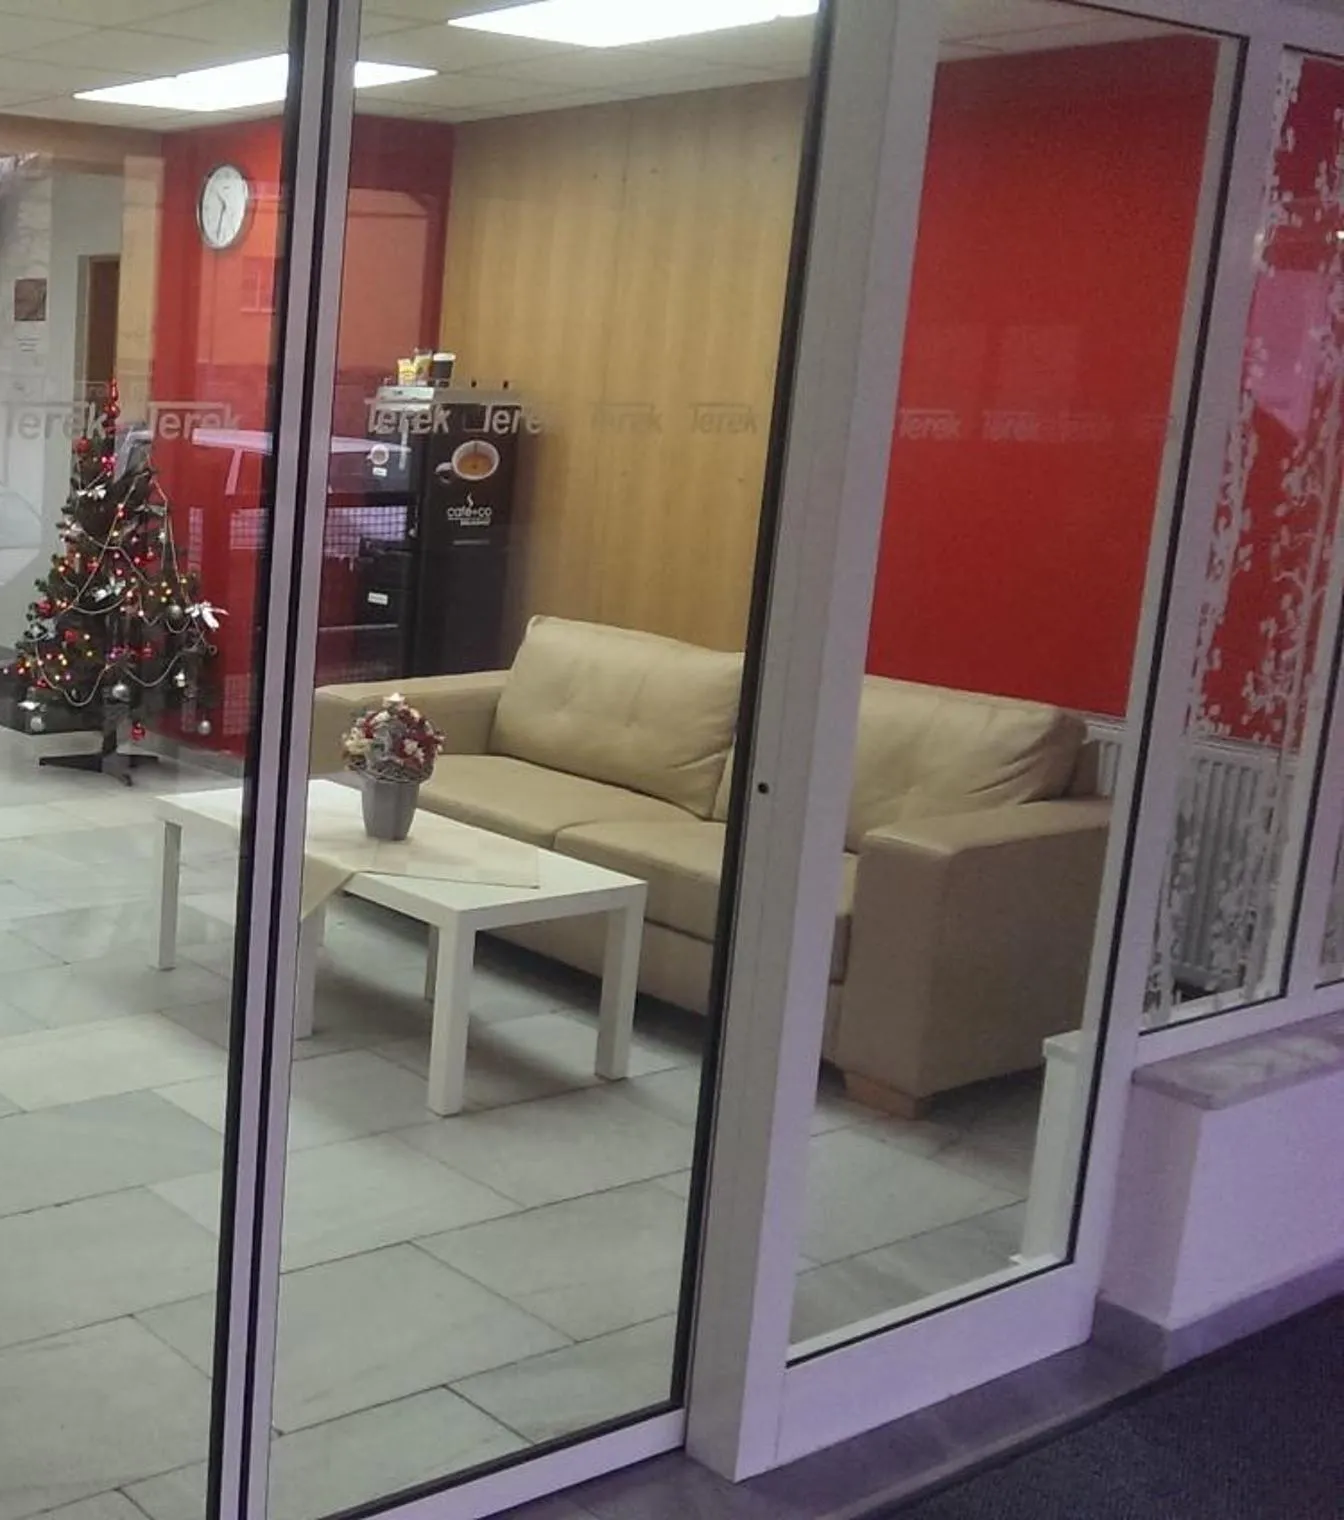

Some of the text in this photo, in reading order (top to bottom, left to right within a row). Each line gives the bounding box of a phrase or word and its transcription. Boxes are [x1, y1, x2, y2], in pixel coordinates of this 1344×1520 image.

[0, 400, 107, 441] Terek
[147, 400, 241, 441] Terek
[364, 399, 451, 435] Terek
[478, 401, 549, 435] Tere
